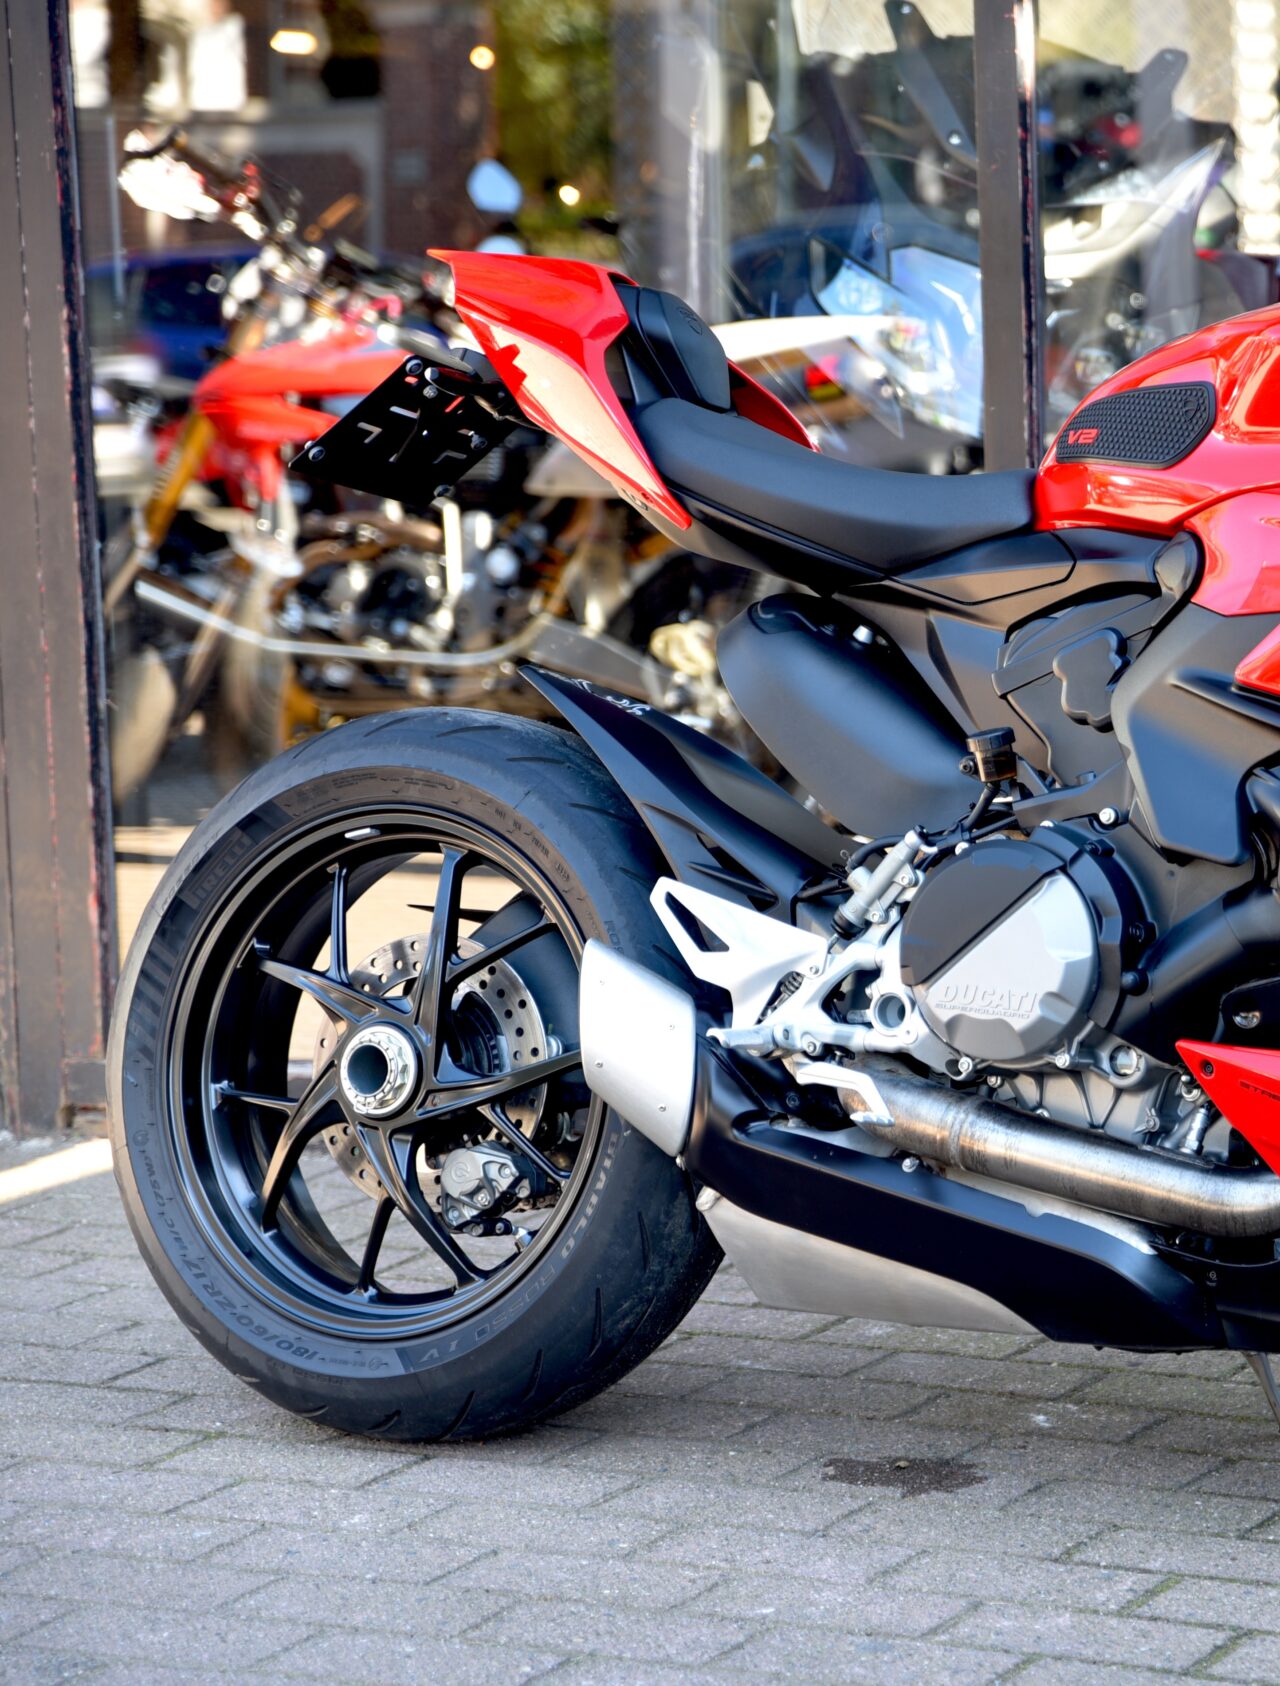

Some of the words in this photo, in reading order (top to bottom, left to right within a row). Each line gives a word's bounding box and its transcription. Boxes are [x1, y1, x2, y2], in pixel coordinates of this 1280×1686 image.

[1067, 428, 1099, 445] V2
[176, 825, 258, 909] PIRELLI
[938, 984, 1038, 1014] DUCATI
[560, 1132, 618, 1260] DIABLO
